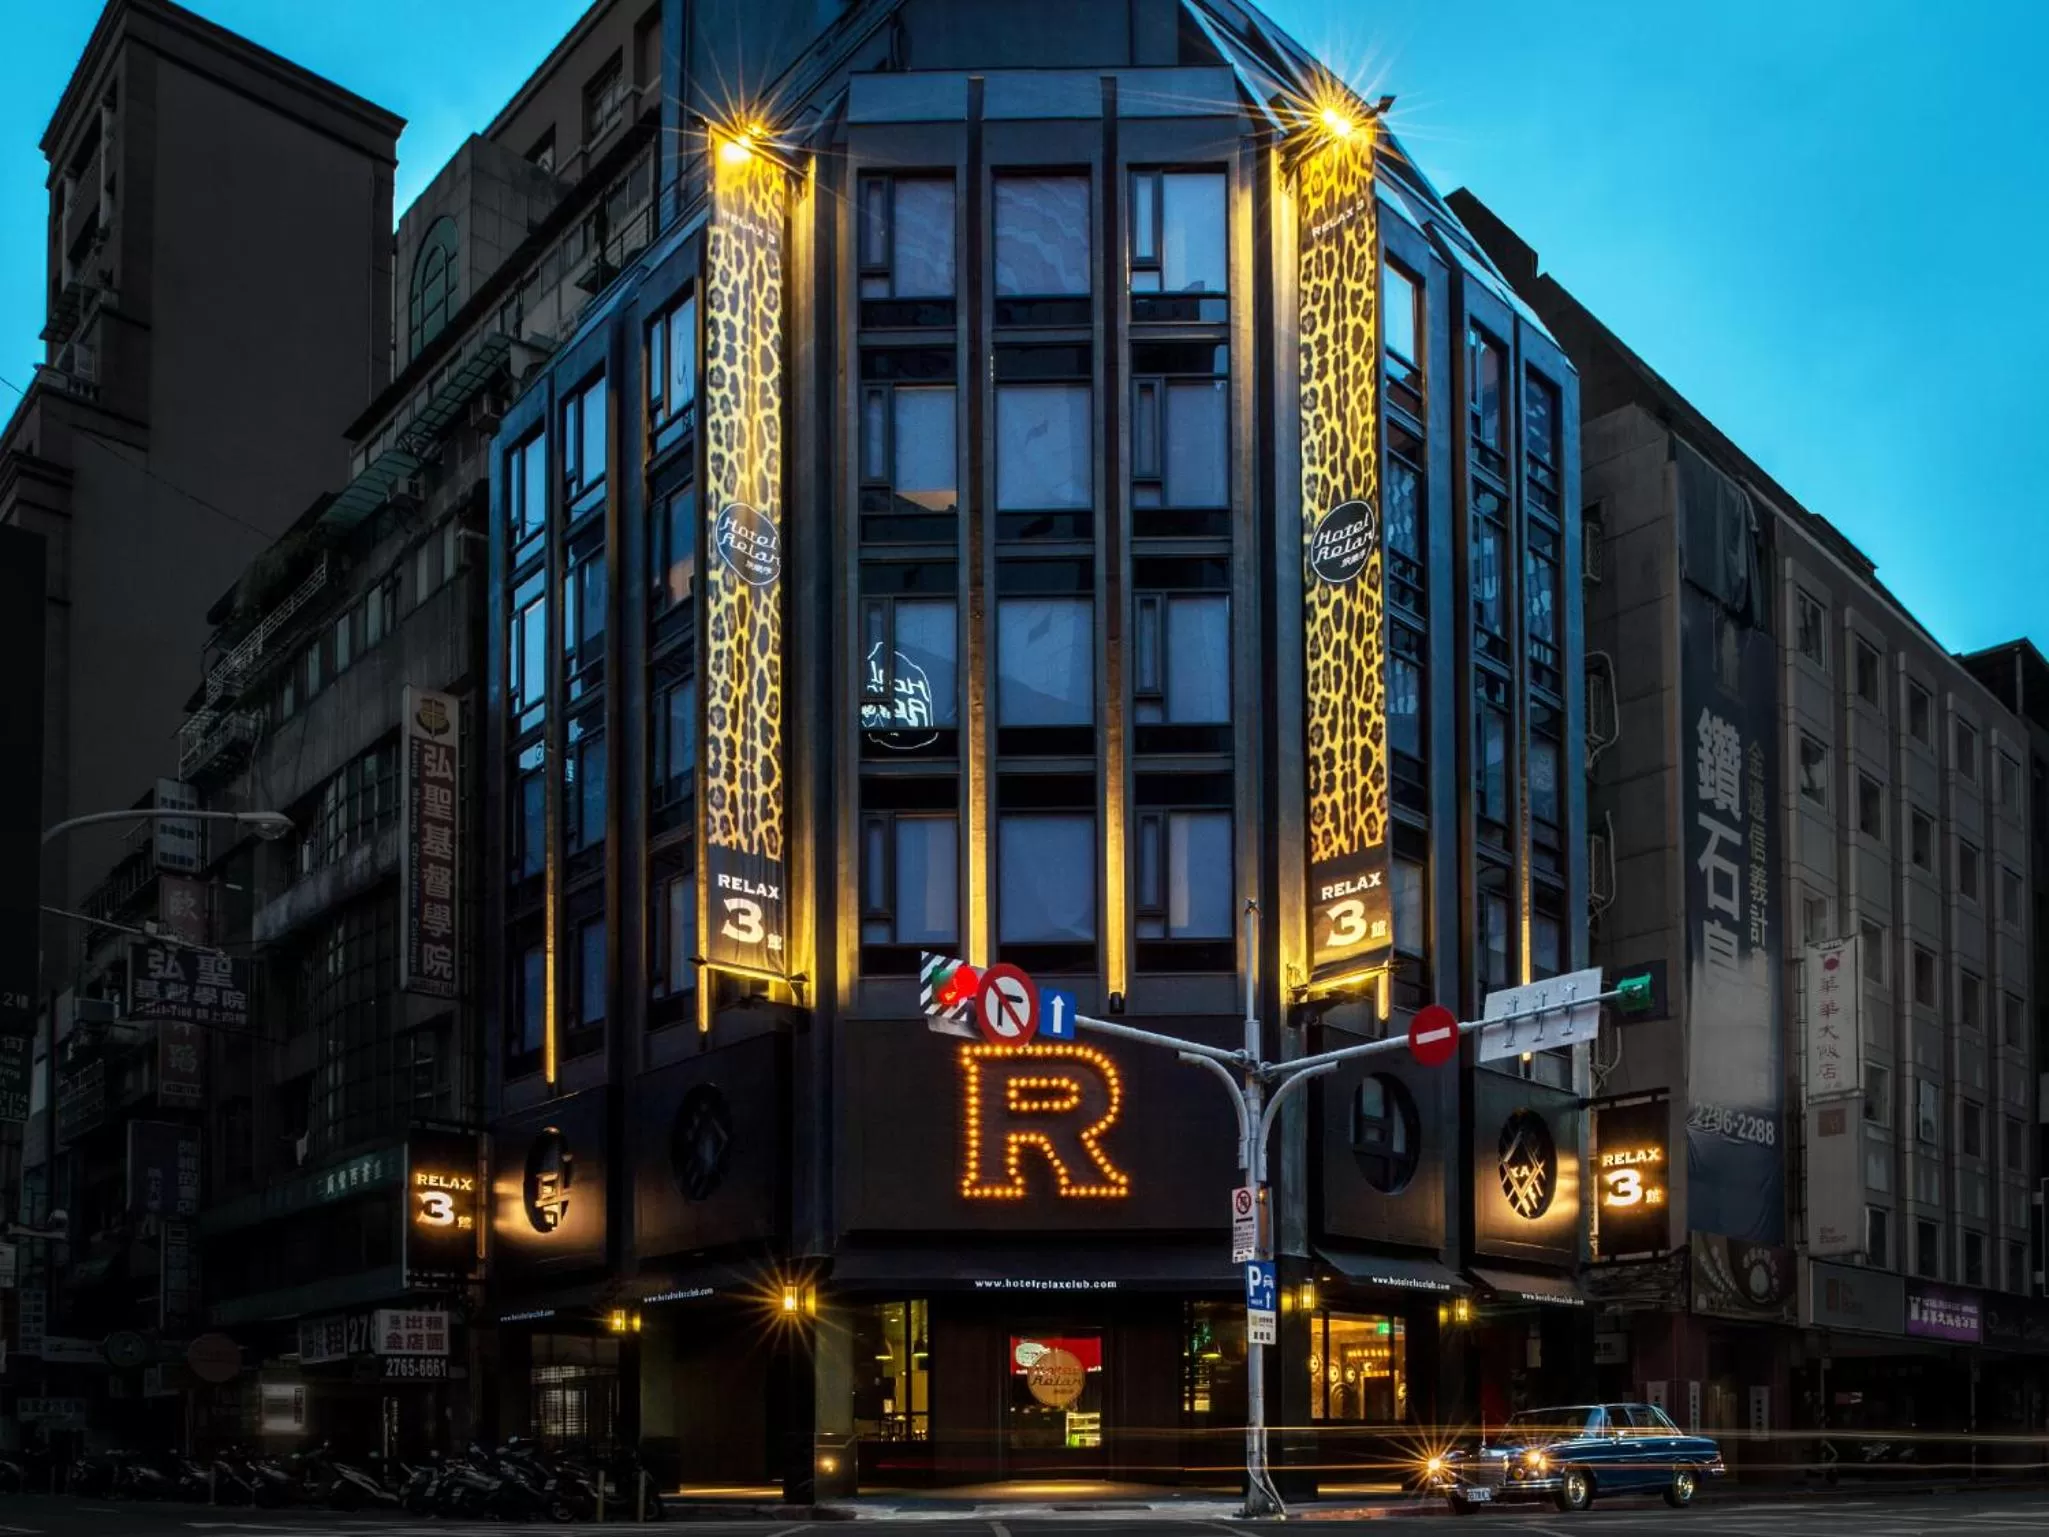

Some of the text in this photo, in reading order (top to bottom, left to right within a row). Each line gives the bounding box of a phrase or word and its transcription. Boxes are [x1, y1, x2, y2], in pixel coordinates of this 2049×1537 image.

[719, 516, 777, 550] Hotel
[1313, 512, 1370, 549] Hotel
[422, 743, 455, 982] 弘聖基督學院
[717, 873, 780, 900] RELAX
[1321, 872, 1382, 900] RELAX
[960, 1043, 1130, 1197] R
[1602, 1147, 1660, 1168] RELAX
[416, 1173, 473, 1191] RELAX
[975, 1278, 1117, 1289] www.hotelrelaxclub.com
[1247, 1265, 1262, 1297] P
